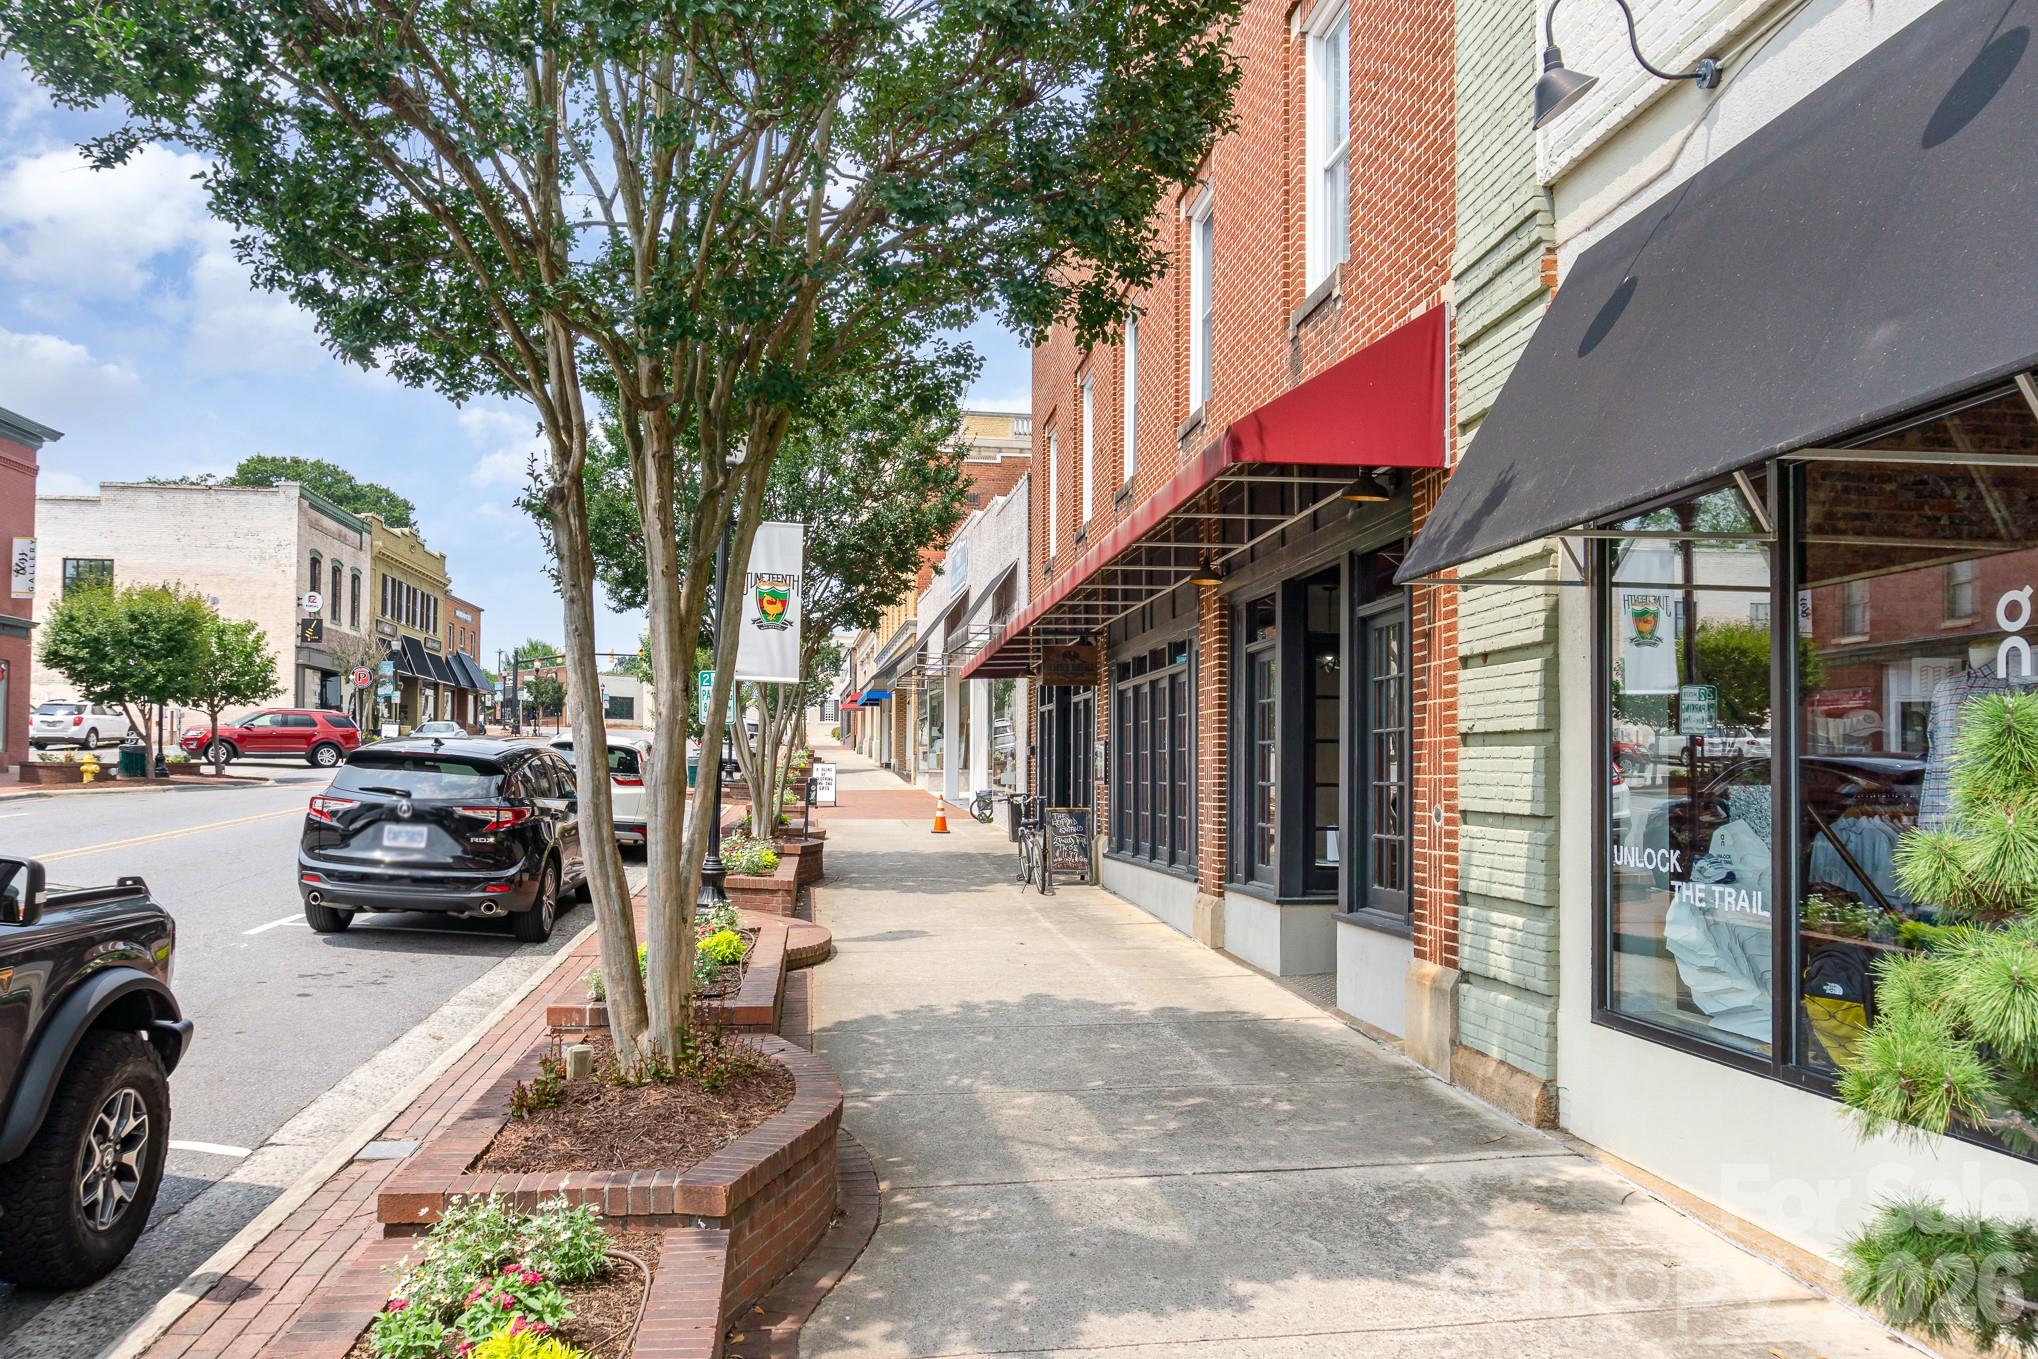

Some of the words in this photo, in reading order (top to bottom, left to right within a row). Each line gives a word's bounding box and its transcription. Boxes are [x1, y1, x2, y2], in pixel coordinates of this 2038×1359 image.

[28, 539, 37, 592] GALLERY
[702, 673, 710, 686] 2
[1612, 845, 1682, 873] UNLOCK
[1670, 880, 1706, 907] THE
[1711, 885, 1771, 918] TRAIL
